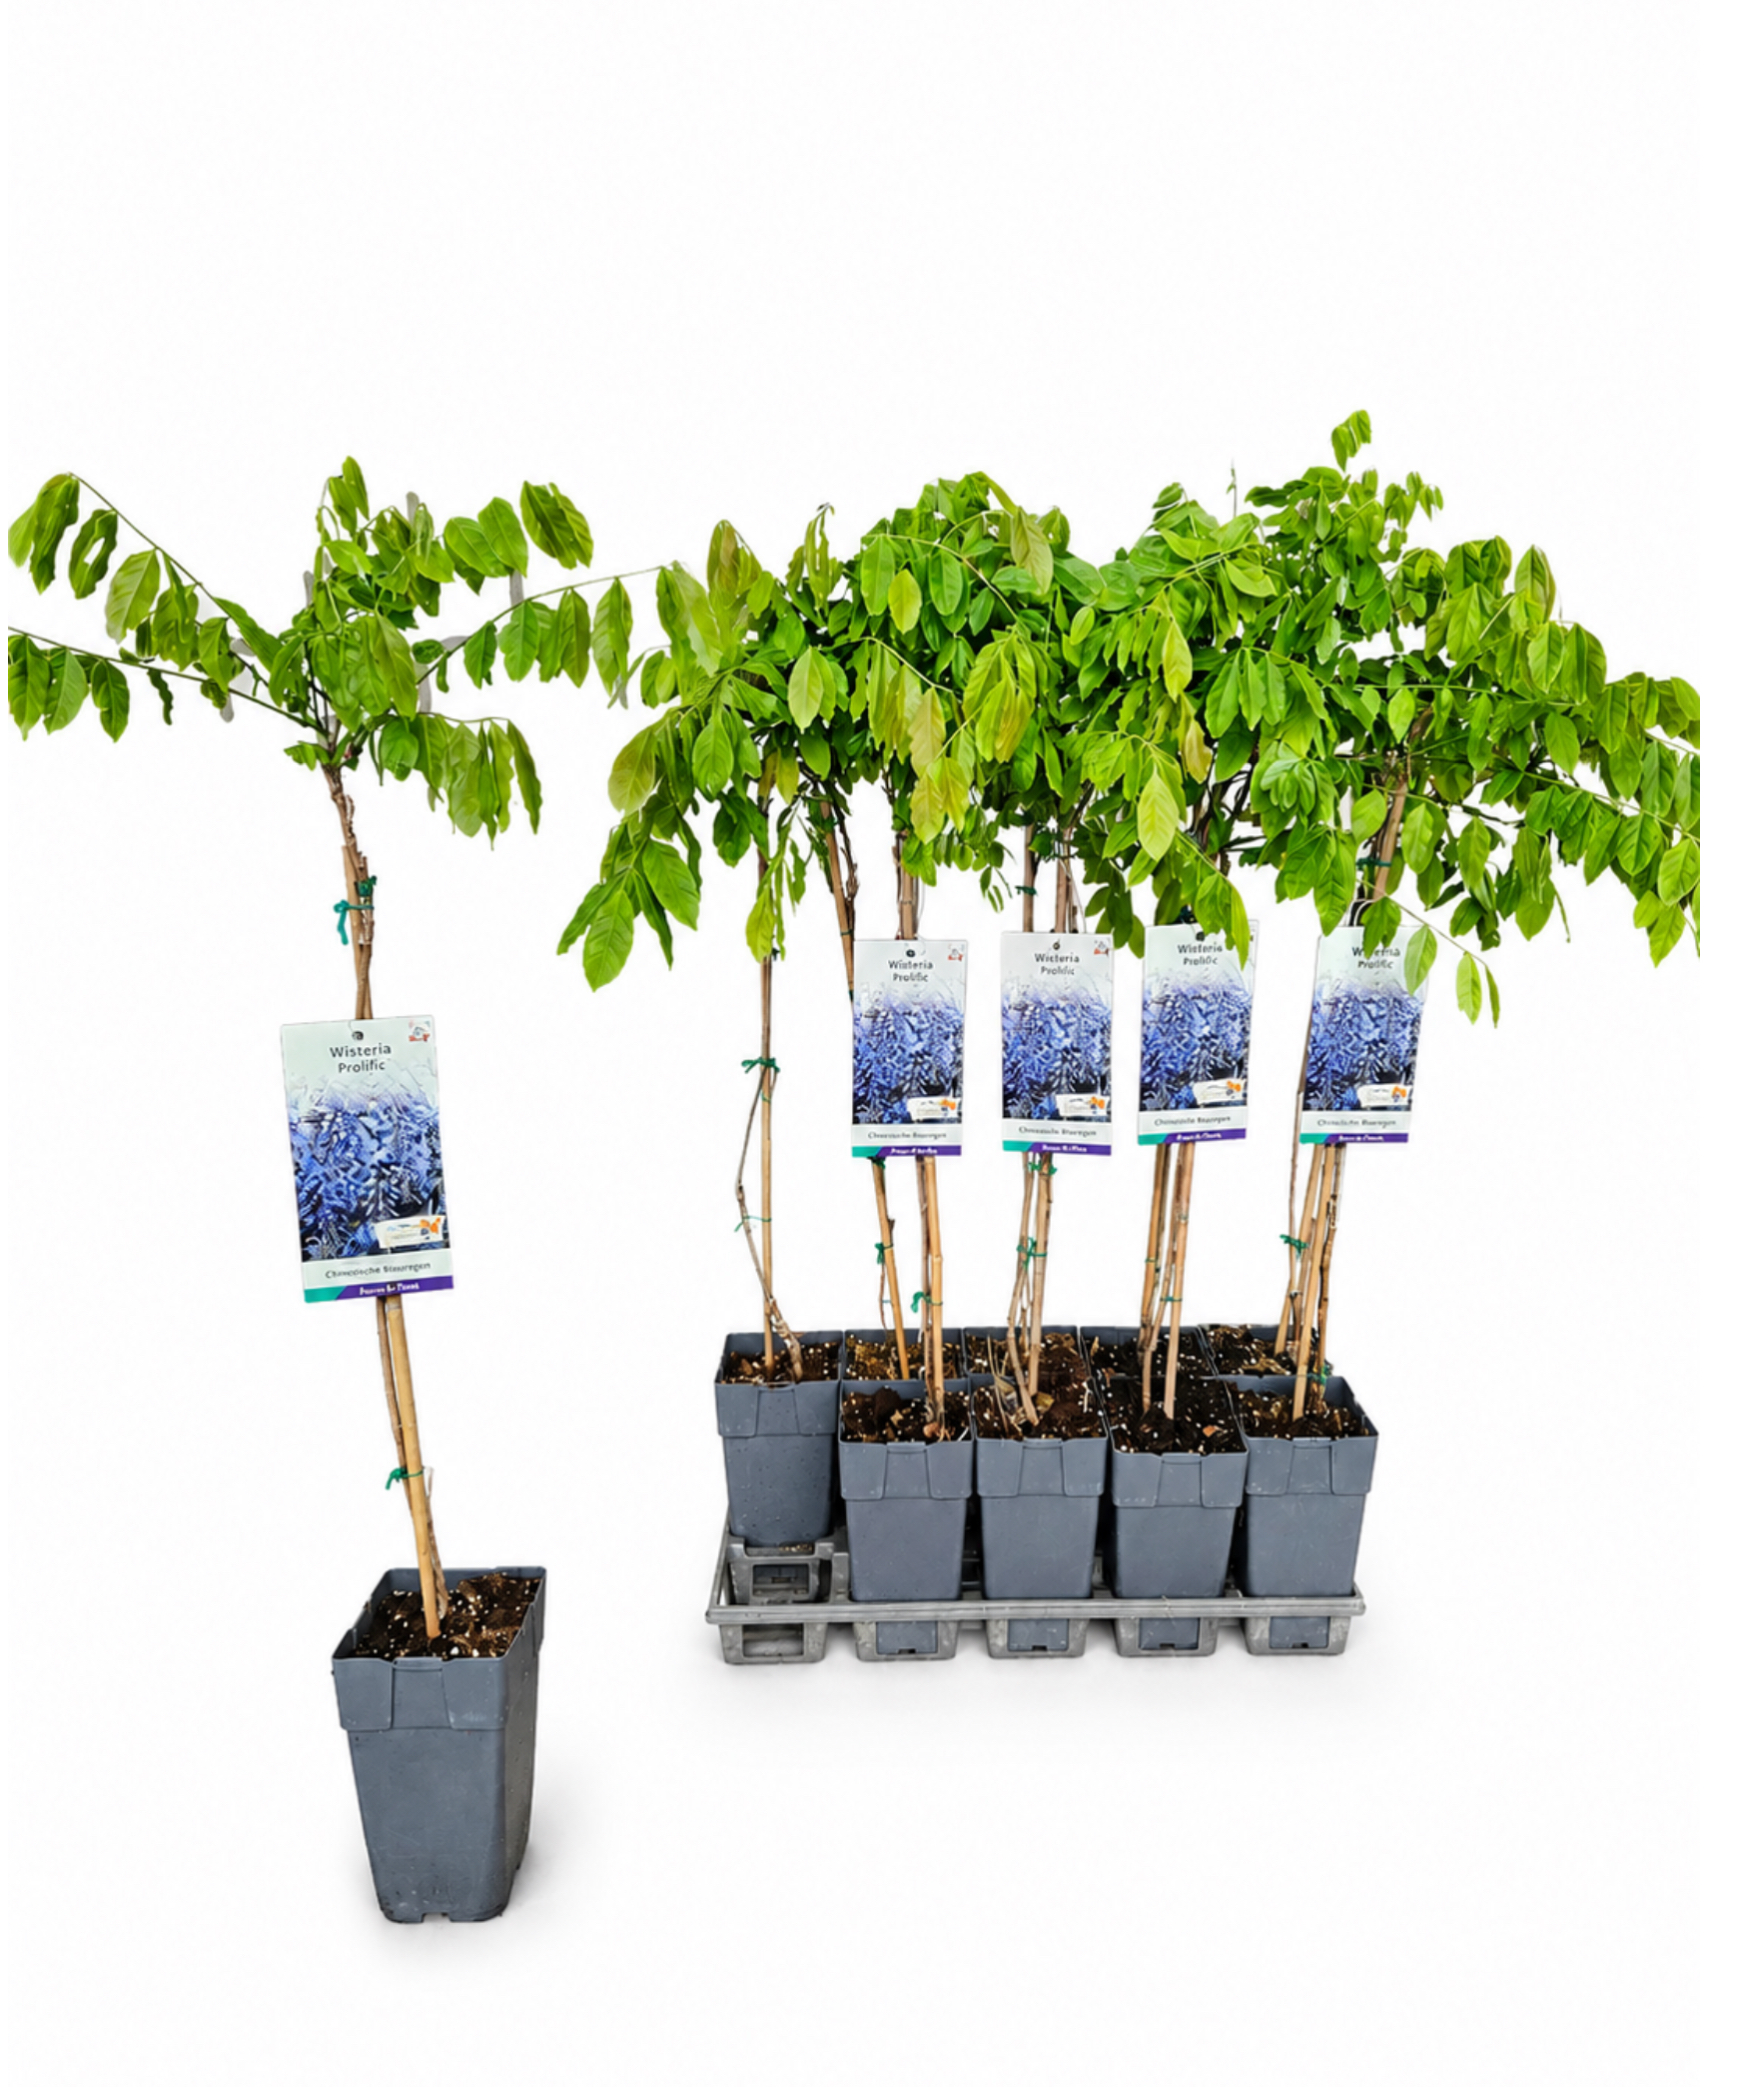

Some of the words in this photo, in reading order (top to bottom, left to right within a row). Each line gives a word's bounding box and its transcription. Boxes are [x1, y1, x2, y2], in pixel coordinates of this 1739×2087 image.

[1352, 946, 1400, 957] Weria
[330, 1043, 392, 1058] Wisteria
[338, 1060, 386, 1073] Prolific
